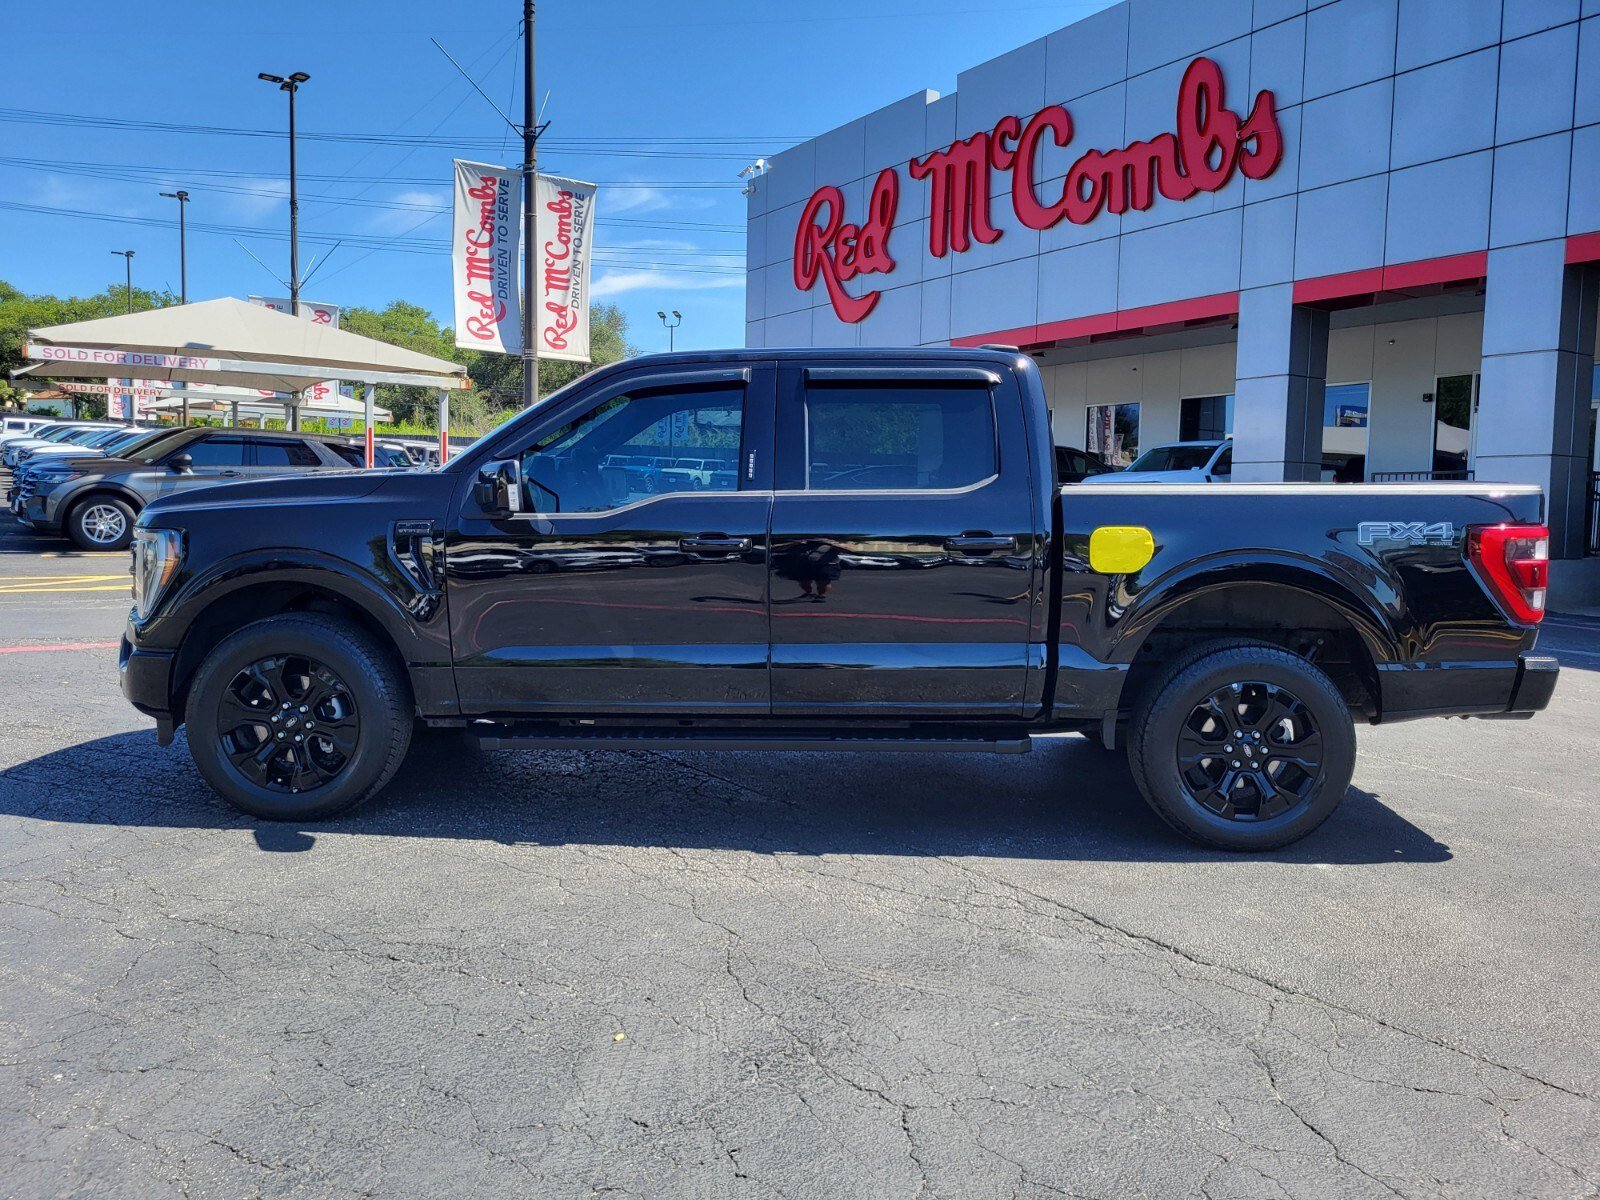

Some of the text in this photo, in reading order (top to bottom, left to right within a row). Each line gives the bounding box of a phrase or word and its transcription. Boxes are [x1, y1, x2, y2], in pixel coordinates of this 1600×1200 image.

[498, 178, 509, 300] DRIVEN TO SERVE
[792, 57, 1283, 324] Red McCombs
[466, 176, 507, 340] Red McCombs
[543, 190, 578, 350] Red McCombs
[571, 192, 585, 309] DRIVEN TO SERVE
[42, 348, 208, 369] SOLD FOR DELIVERY
[58, 383, 87, 392] SOLD
[90, 385, 110, 393] FOR
[113, 386, 163, 396] DELIVERY
[1357, 521, 1454, 545] FX4
